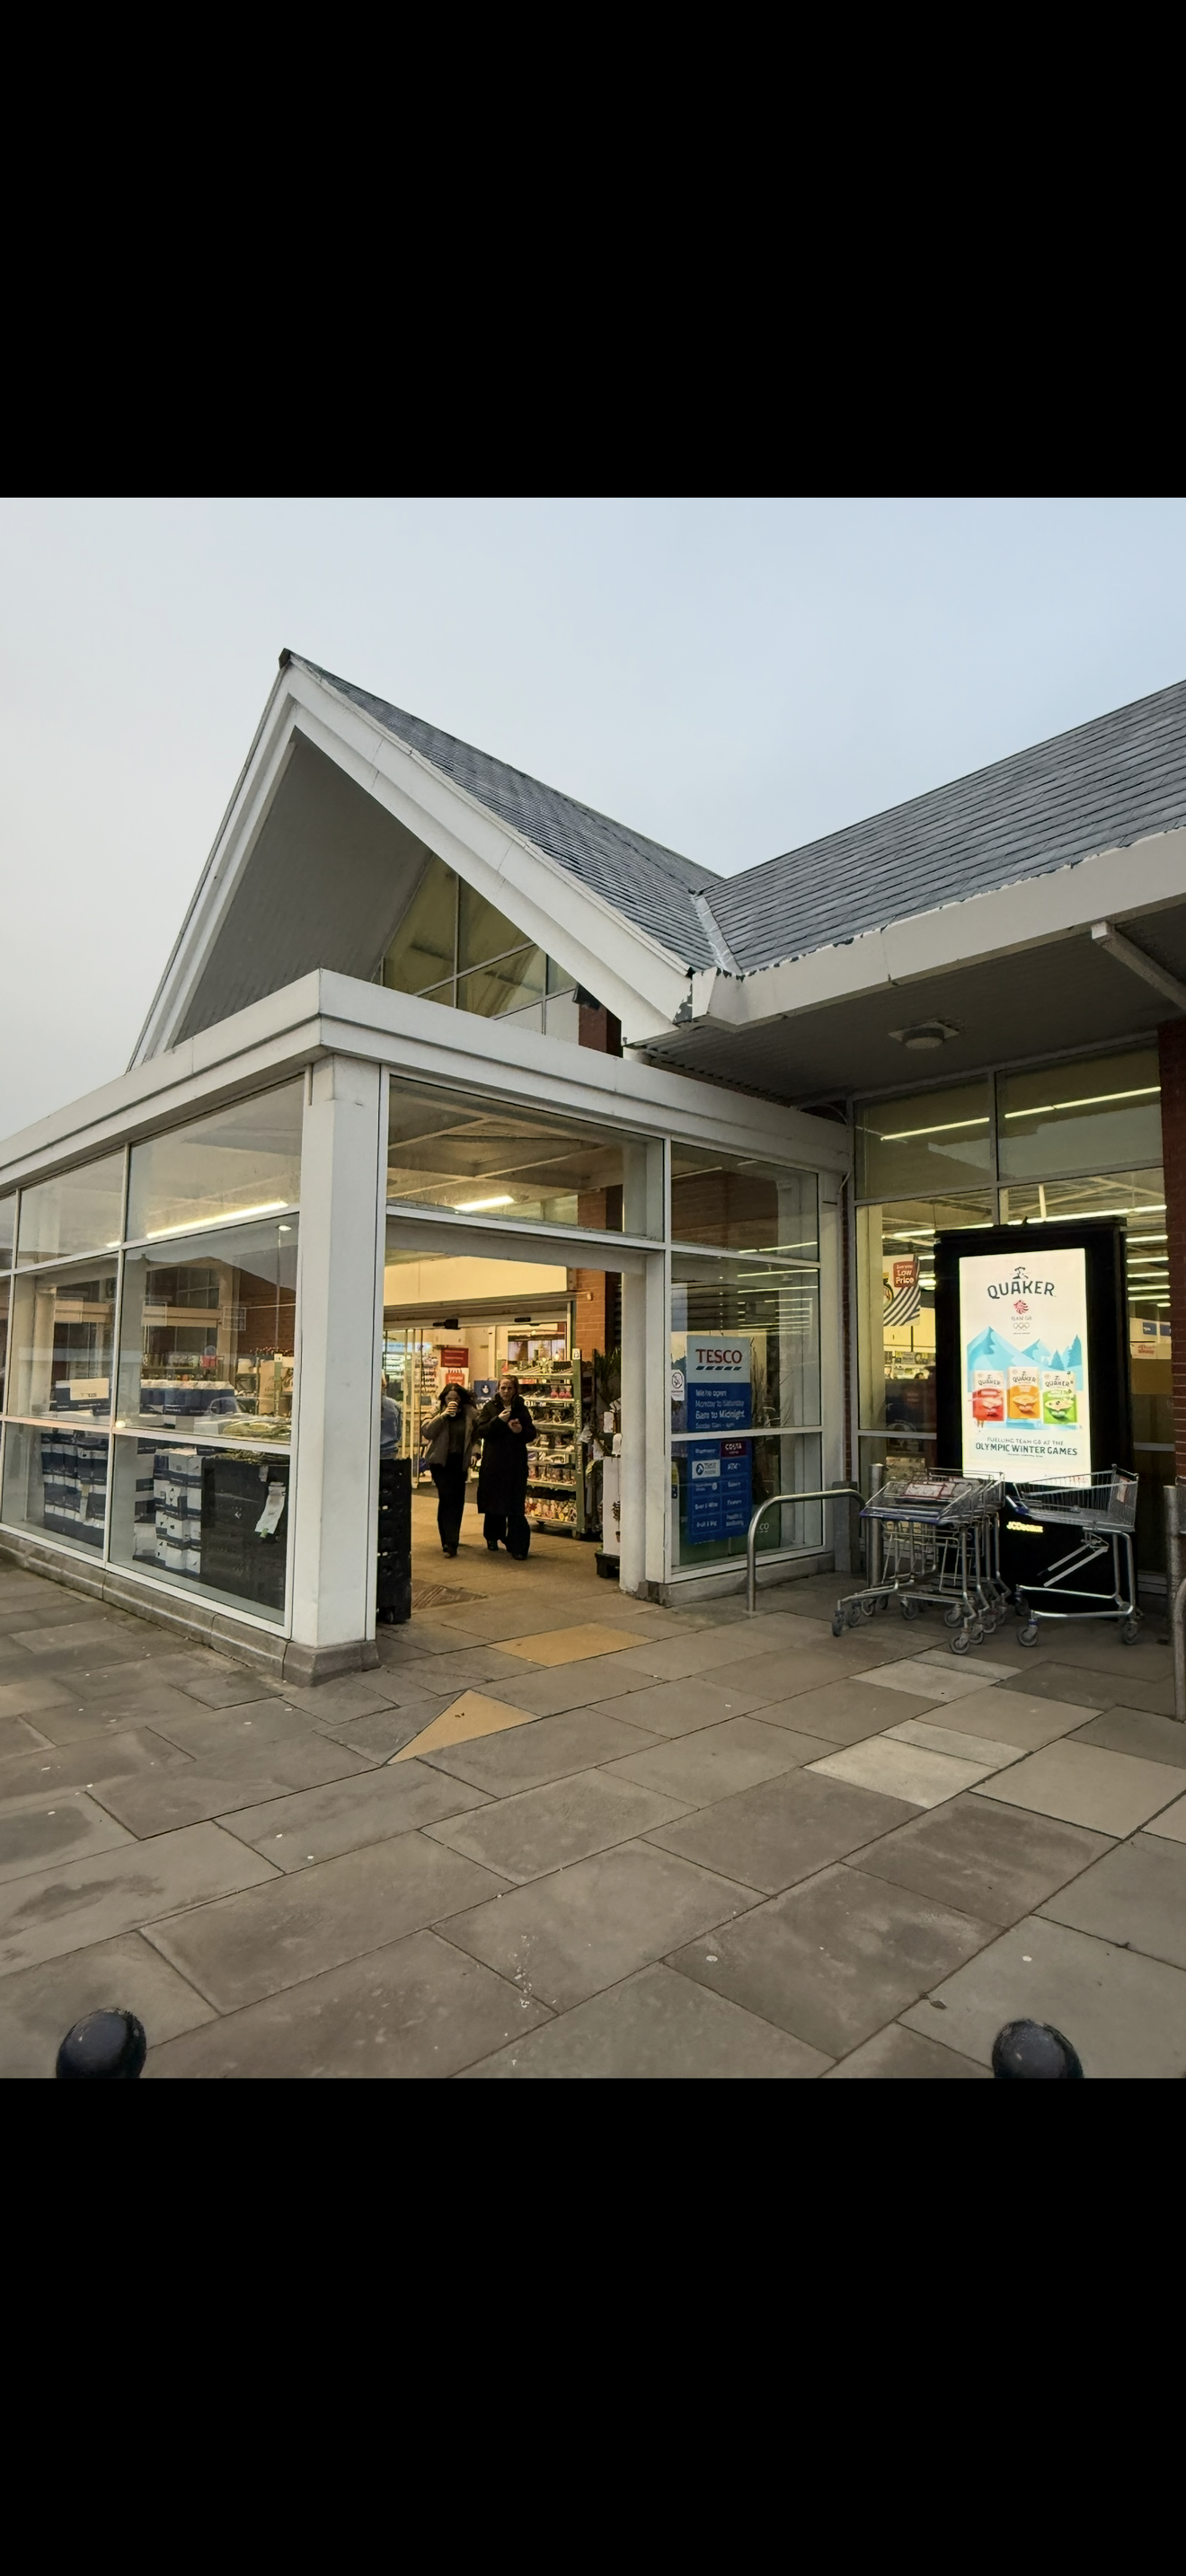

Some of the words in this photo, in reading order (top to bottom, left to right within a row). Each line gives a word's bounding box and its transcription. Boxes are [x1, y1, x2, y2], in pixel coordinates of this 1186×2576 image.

[896, 1276, 915, 1284] Price
[987, 1280, 1056, 1300] QUAKER
[695, 1349, 743, 1363] TESCO
[695, 1400, 716, 1408] Monday
[695, 1410, 710, 1419] 6am
[719, 1409, 746, 1420] Midnight
[724, 1442, 742, 1451] COSTA
[975, 1442, 1011, 1452] OLYMPIC
[1012, 1444, 1046, 1454] WINTER
[1047, 1446, 1078, 1456] GAMES
